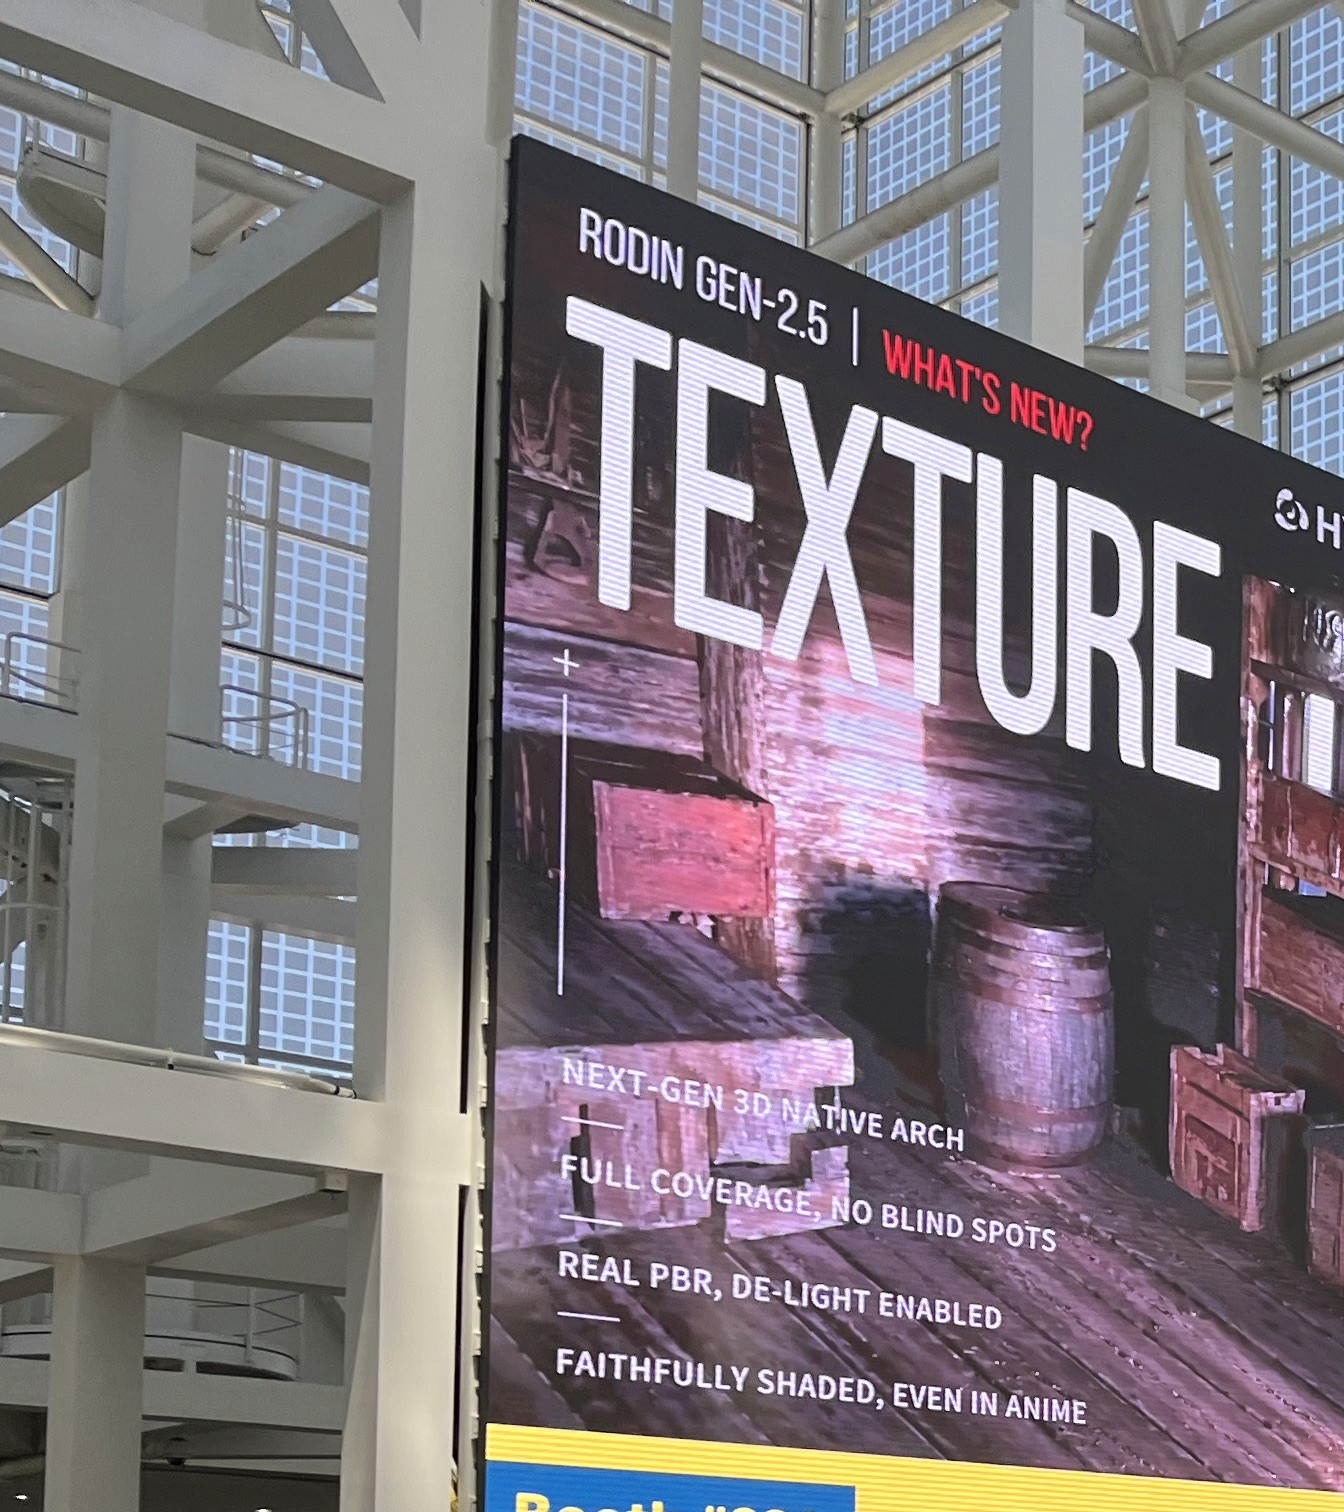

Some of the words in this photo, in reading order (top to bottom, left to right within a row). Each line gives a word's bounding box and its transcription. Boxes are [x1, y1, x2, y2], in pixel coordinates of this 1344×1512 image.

[579, 208, 684, 291] RODIN
[695, 255, 829, 347] GEN-2.5
[881, 328, 1002, 416] WHAT'S
[1010, 380, 1095, 452] NEW?
[565, 295, 1222, 793] TEXTURE
[561, 1056, 725, 1113] NEXT-GEN
[735, 1089, 773, 1120] 3D
[781, 1100, 884, 1140] NATIVE
[891, 1117, 966, 1153] ARCH
[559, 1155, 642, 1193] FULL
[650, 1167, 823, 1223] COVERAGE,
[831, 1195, 874, 1227] NO
[881, 1202, 965, 1239] BLIND
[970, 1216, 1059, 1253] SPOTS
[557, 1249, 641, 1287] REAL
[650, 1261, 723, 1302] PBR,
[731, 1272, 872, 1314] DE-LIGHT
[878, 1292, 1003, 1331] ENABLED
[556, 1348, 750, 1393] FAITHFULLY
[756, 1368, 885, 1412] SHADED,
[892, 1382, 963, 1414] EVEN
[971, 1391, 999, 1418] IN
[1004, 1394, 1088, 1426] ANIME
